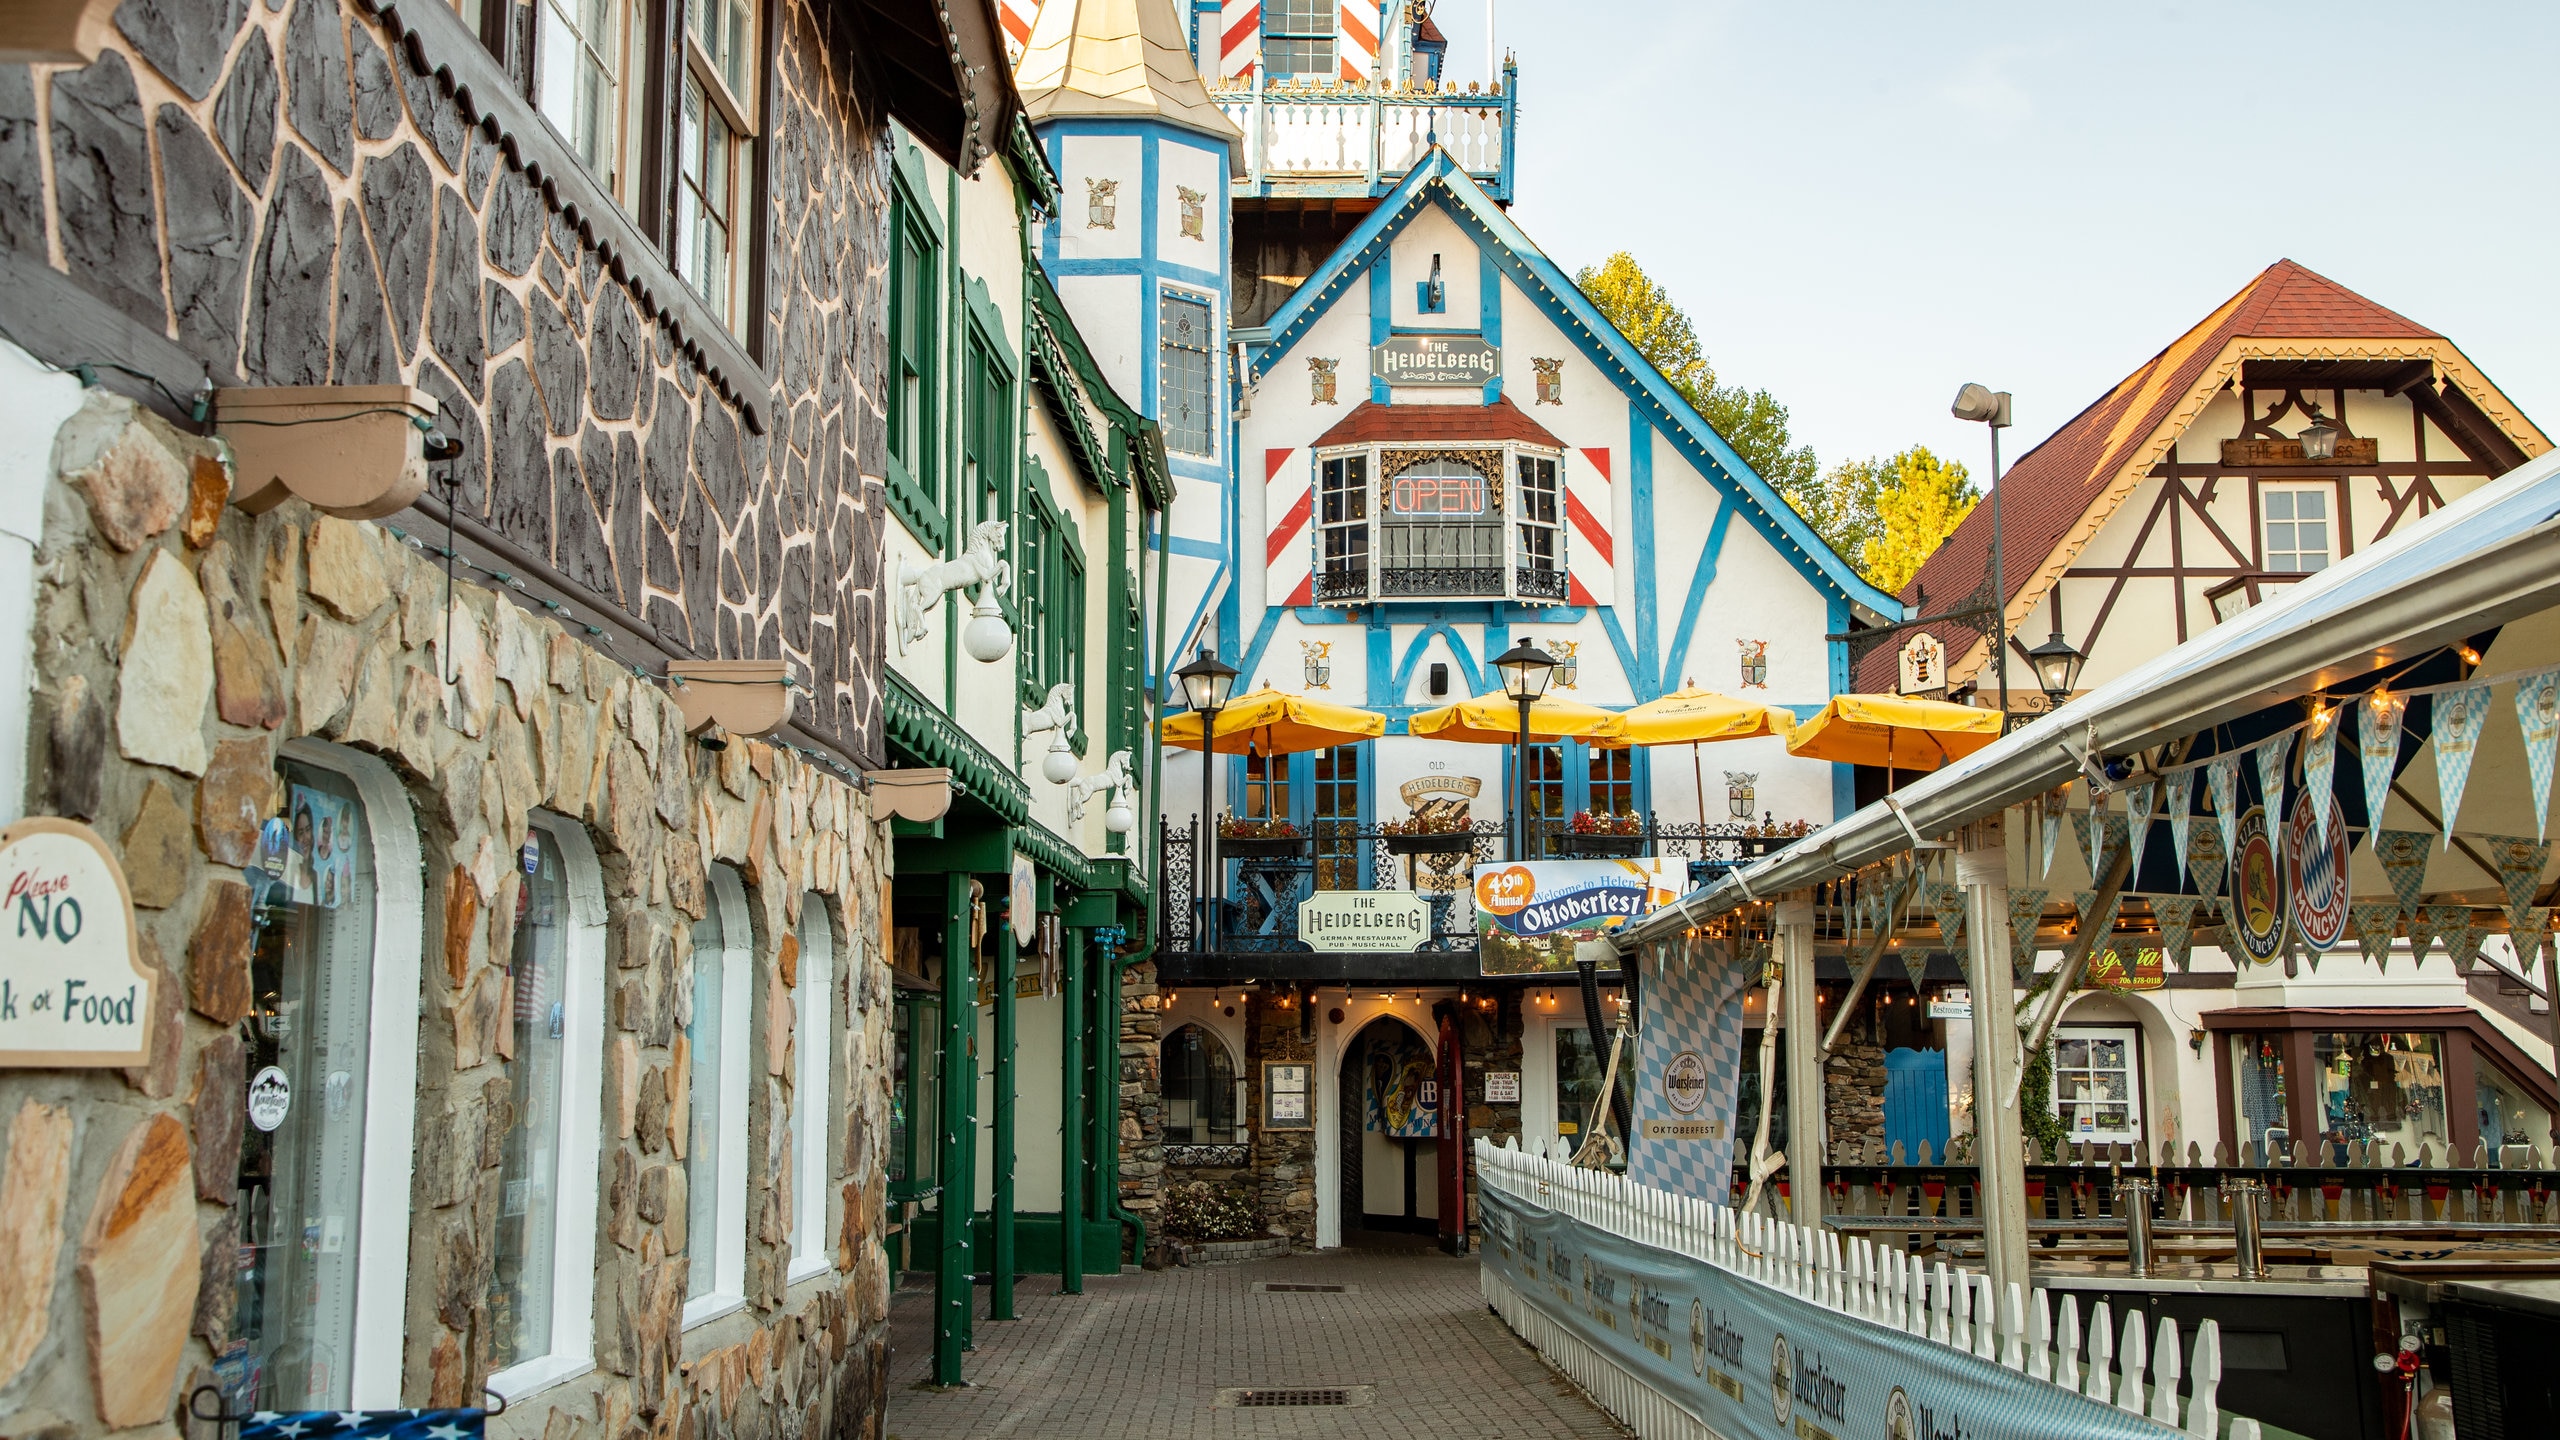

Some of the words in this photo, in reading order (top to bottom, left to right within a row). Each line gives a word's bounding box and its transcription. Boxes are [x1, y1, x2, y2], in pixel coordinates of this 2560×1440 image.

[1428, 342, 1449, 352] THE
[1382, 349, 1494, 375] HEIDELBERG
[2244, 445, 2273, 459] THE
[1395, 479, 1480, 511] OPEN
[1429, 761, 1445, 770] OLD
[1408, 778, 1471, 793] HEIDELBERG
[2290, 828, 2302, 861] FC
[3, 867, 70, 910] Please
[1488, 873, 1523, 895] 49th
[1531, 883, 1582, 904] Welcome
[1583, 879, 1595, 889] to
[1600, 875, 1636, 889] Helen
[1353, 897, 1376, 908] THE
[1489, 893, 1524, 907] Annual
[1523, 889, 1641, 932] Oktoberfest
[17, 890, 83, 945] NO
[1308, 908, 1421, 935] HEIDELBERG
[63, 978, 136, 1026] Food
[1932, 1005, 1963, 1014] Restrooms
[1668, 1073, 1705, 1092] Warsteiner
[1652, 1126, 1716, 1135] OKTOBERFEST
[2099, 1114, 2121, 1124] Closed
[1706, 1307, 1744, 1370] Warsteiner
[1794, 1345, 1846, 1427] Warsteiner
